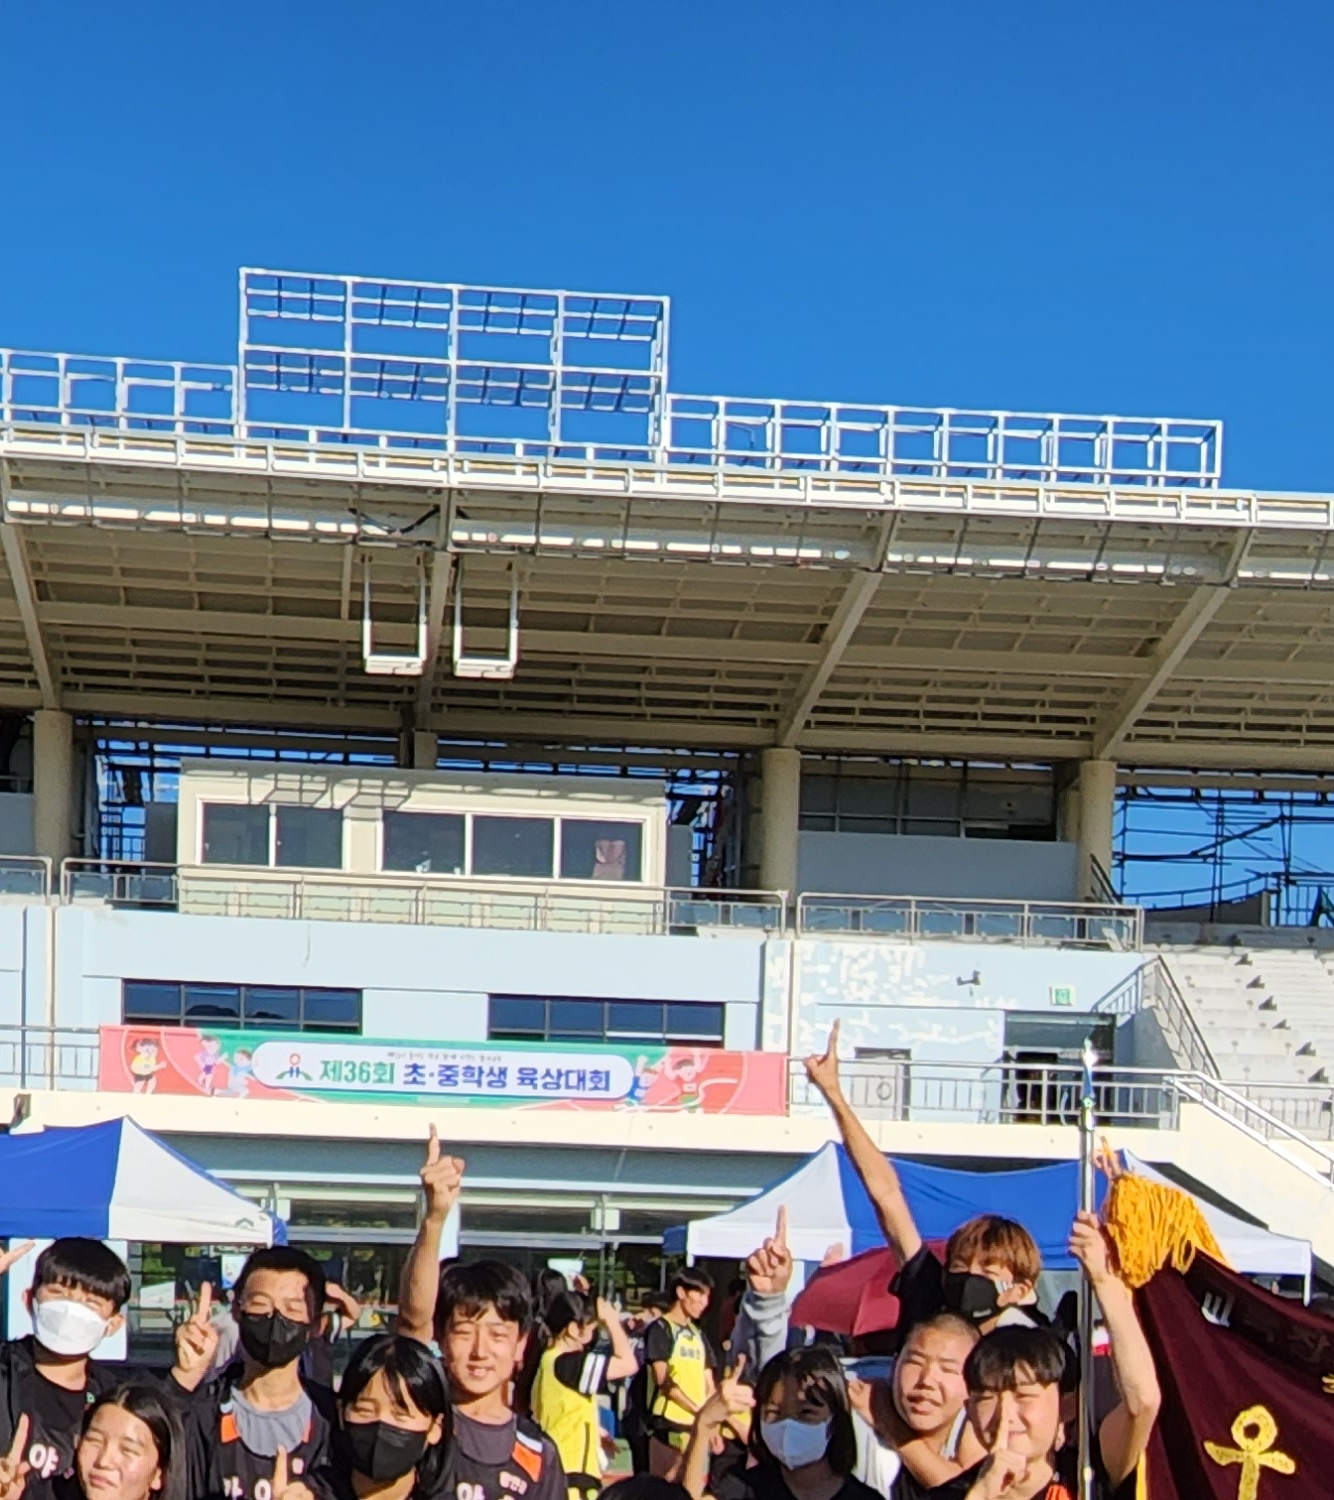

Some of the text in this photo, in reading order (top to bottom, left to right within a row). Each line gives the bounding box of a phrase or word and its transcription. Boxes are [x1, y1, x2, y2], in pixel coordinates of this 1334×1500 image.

[319, 1059, 611, 1092] 제36회 초·중학생 육상대회
